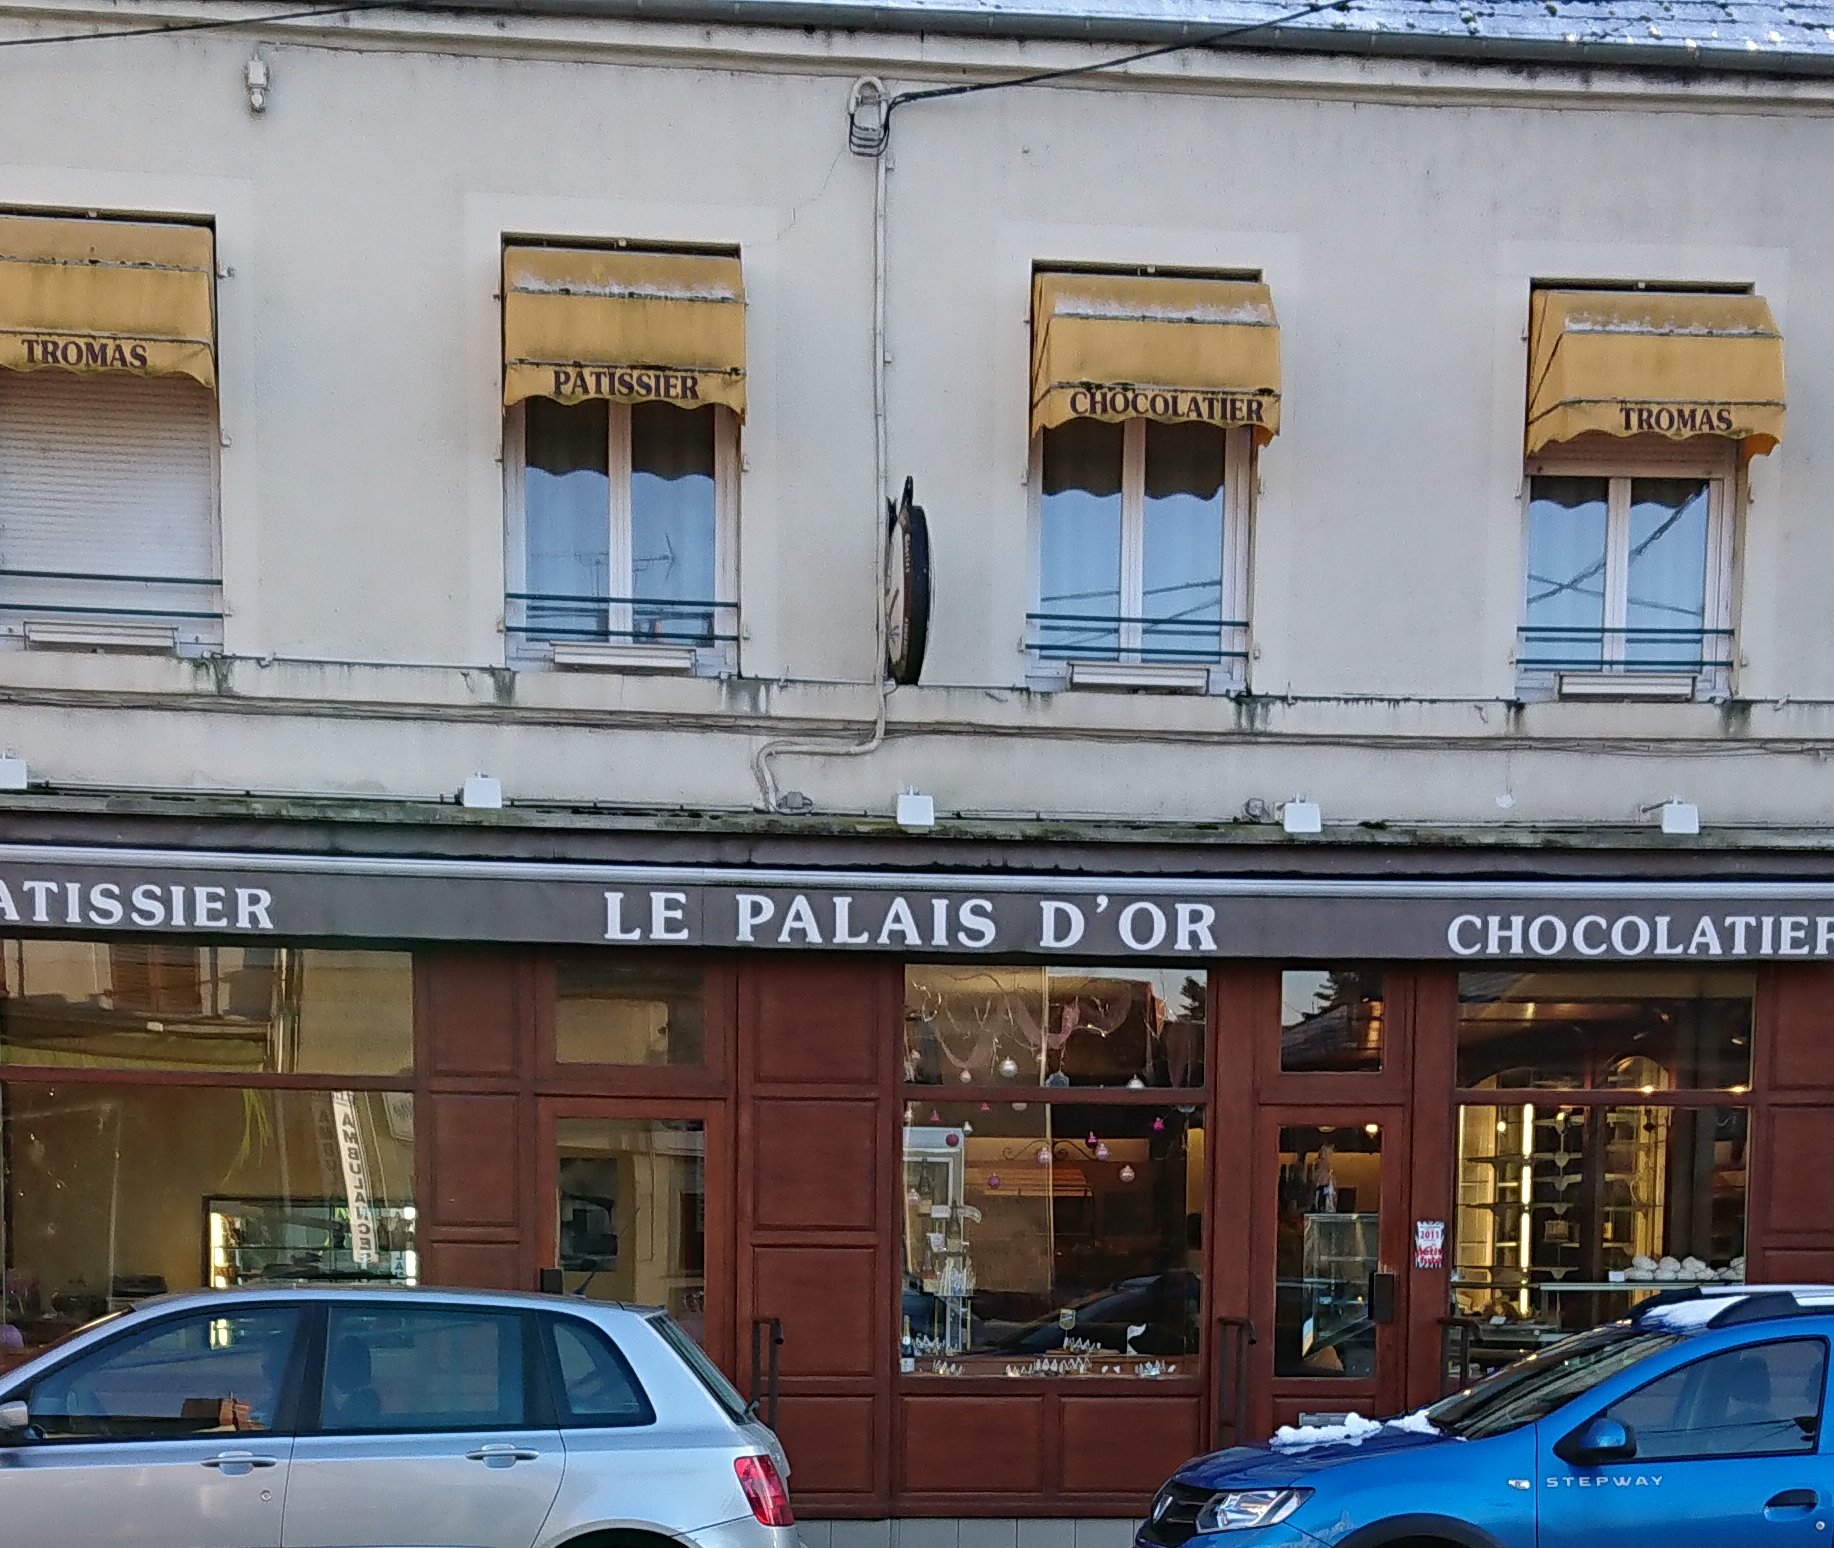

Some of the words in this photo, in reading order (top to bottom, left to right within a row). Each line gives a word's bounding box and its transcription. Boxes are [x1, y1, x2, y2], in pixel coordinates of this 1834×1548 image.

[21, 338, 149, 369] TROMAS
[1069, 390, 1264, 423] CHOCOLATIER
[1619, 407, 1733, 432] TROMAS
[604, 891, 690, 941] LE
[736, 894, 998, 949] PALAIS
[1040, 894, 1218, 952] D'OR
[1546, 1475, 1663, 1488] STEPWAY
